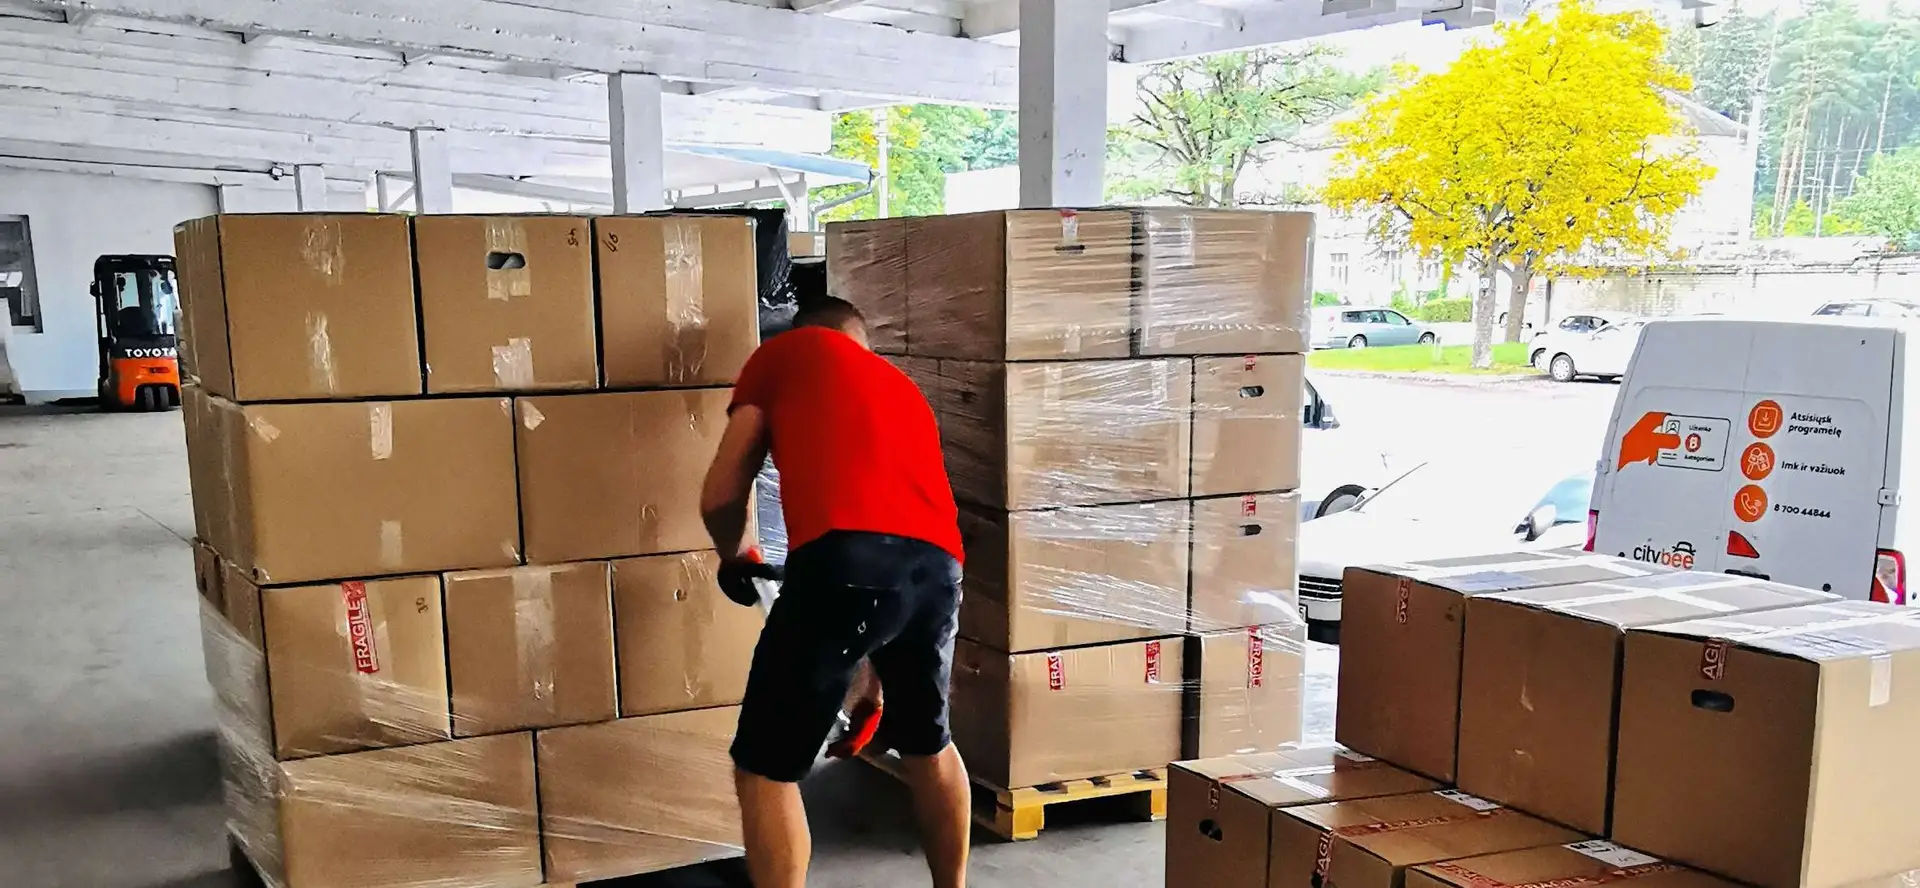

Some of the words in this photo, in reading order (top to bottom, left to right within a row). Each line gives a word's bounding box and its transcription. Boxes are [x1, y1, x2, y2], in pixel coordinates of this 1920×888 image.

[125, 347, 178, 358] TOYOTA
[1781, 460, 1799, 470] Imk
[1800, 462, 1808, 471] ir
[1810, 463, 1846, 476] važiuok
[1773, 503, 1780, 512] 8
[1782, 504, 1800, 515] 700
[1801, 507, 1831, 519] 44844
[346, 597, 373, 669] FRAGILE
